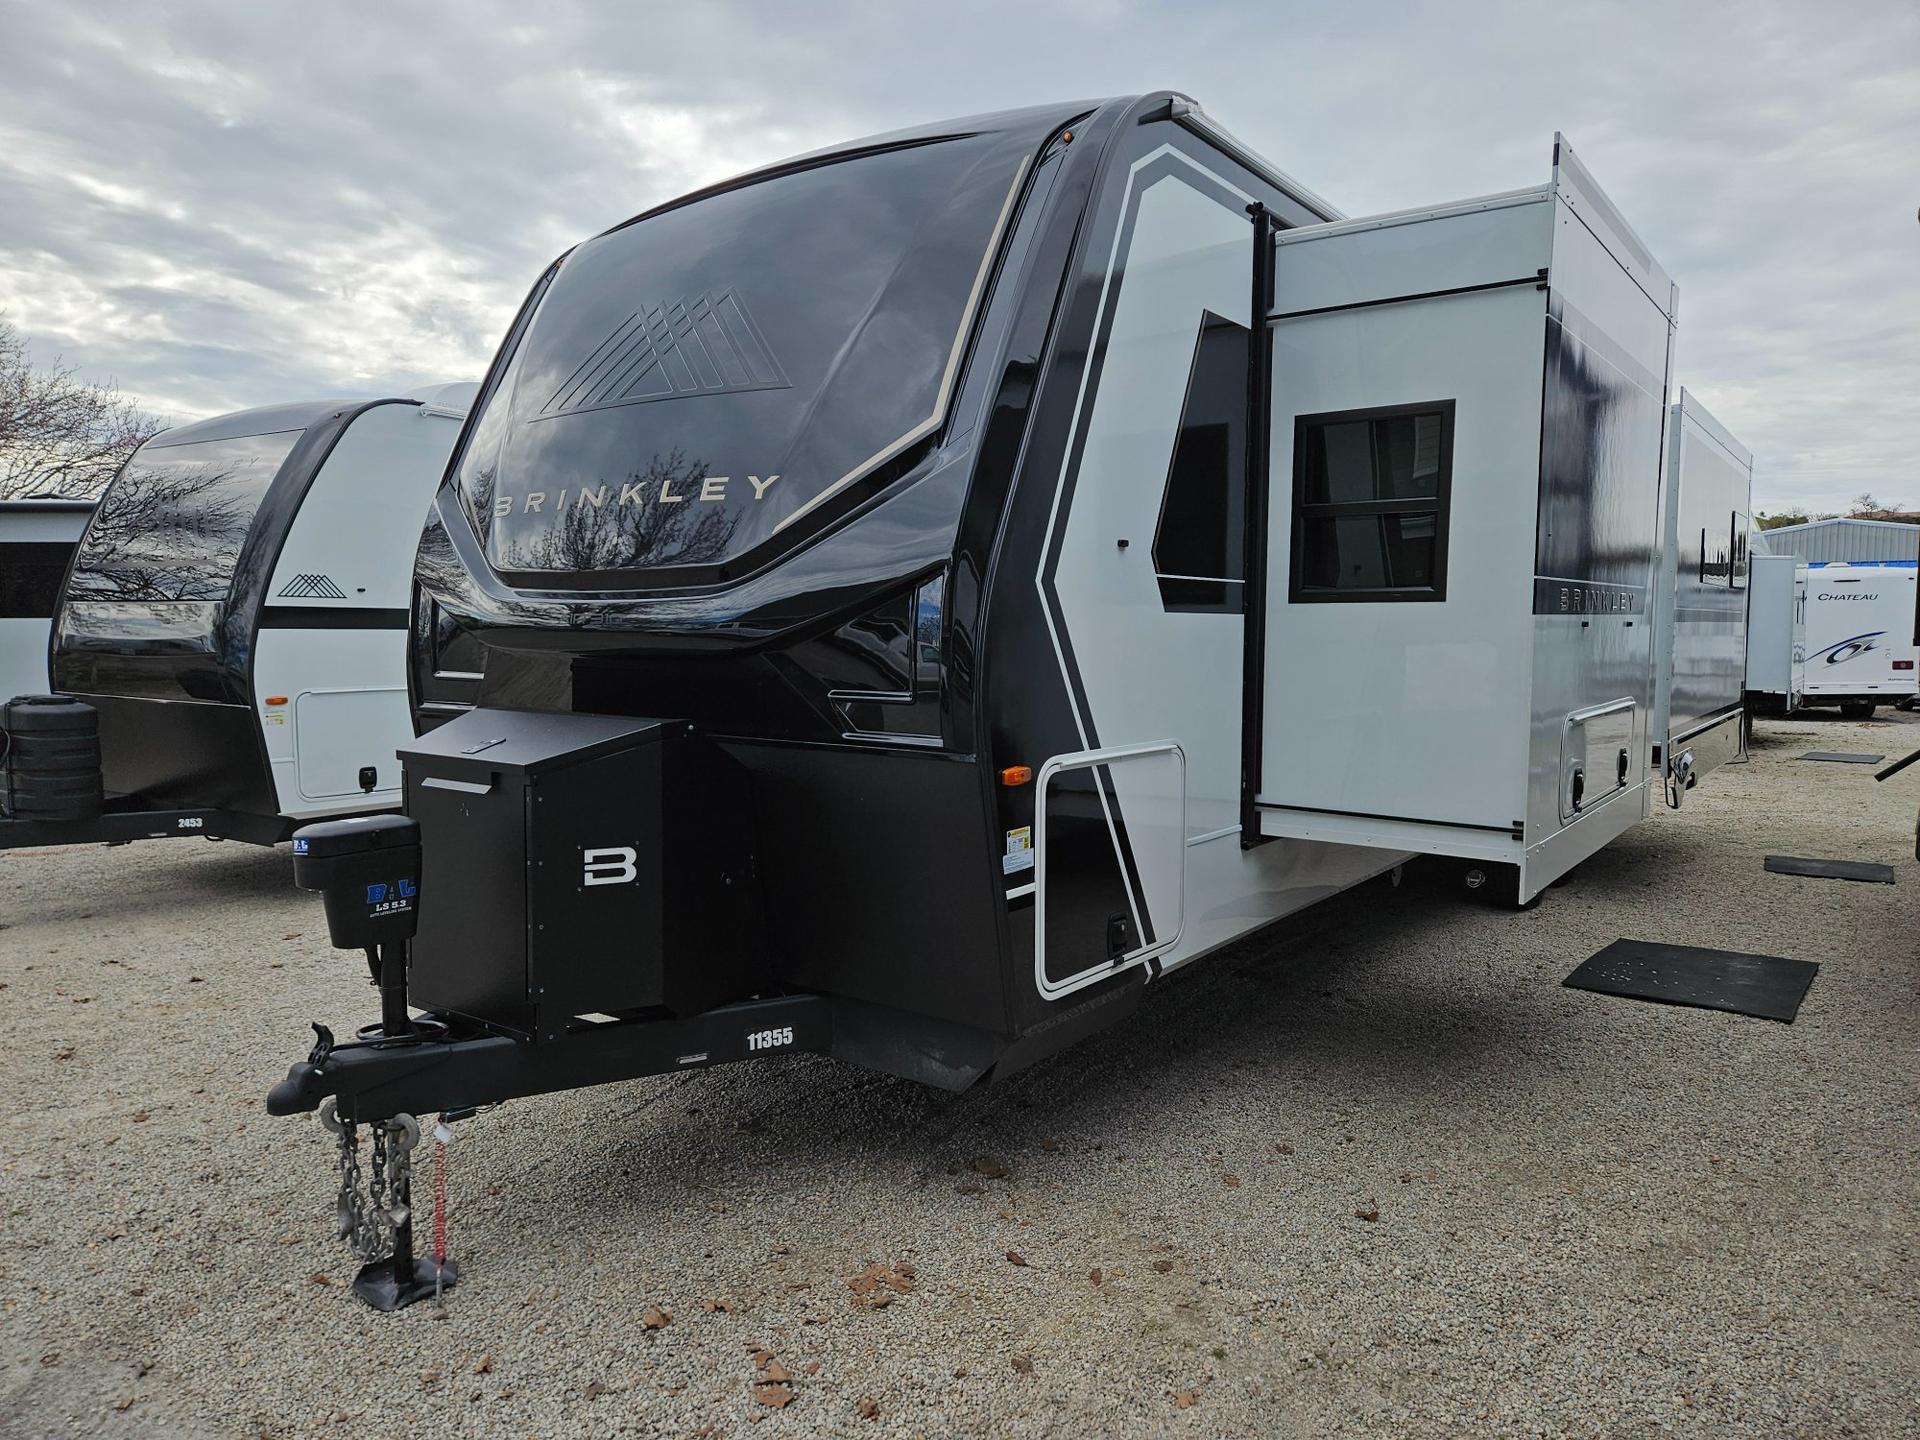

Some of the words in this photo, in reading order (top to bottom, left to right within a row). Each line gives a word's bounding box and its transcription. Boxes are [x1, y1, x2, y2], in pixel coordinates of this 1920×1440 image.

[494, 475, 779, 517] BRINKLEY
[1560, 587, 1635, 612] BRINKLEY
[178, 817, 203, 828] 2453
[584, 846, 637, 886] B
[375, 902, 390, 912] LS
[746, 1026, 794, 1051] 11355
